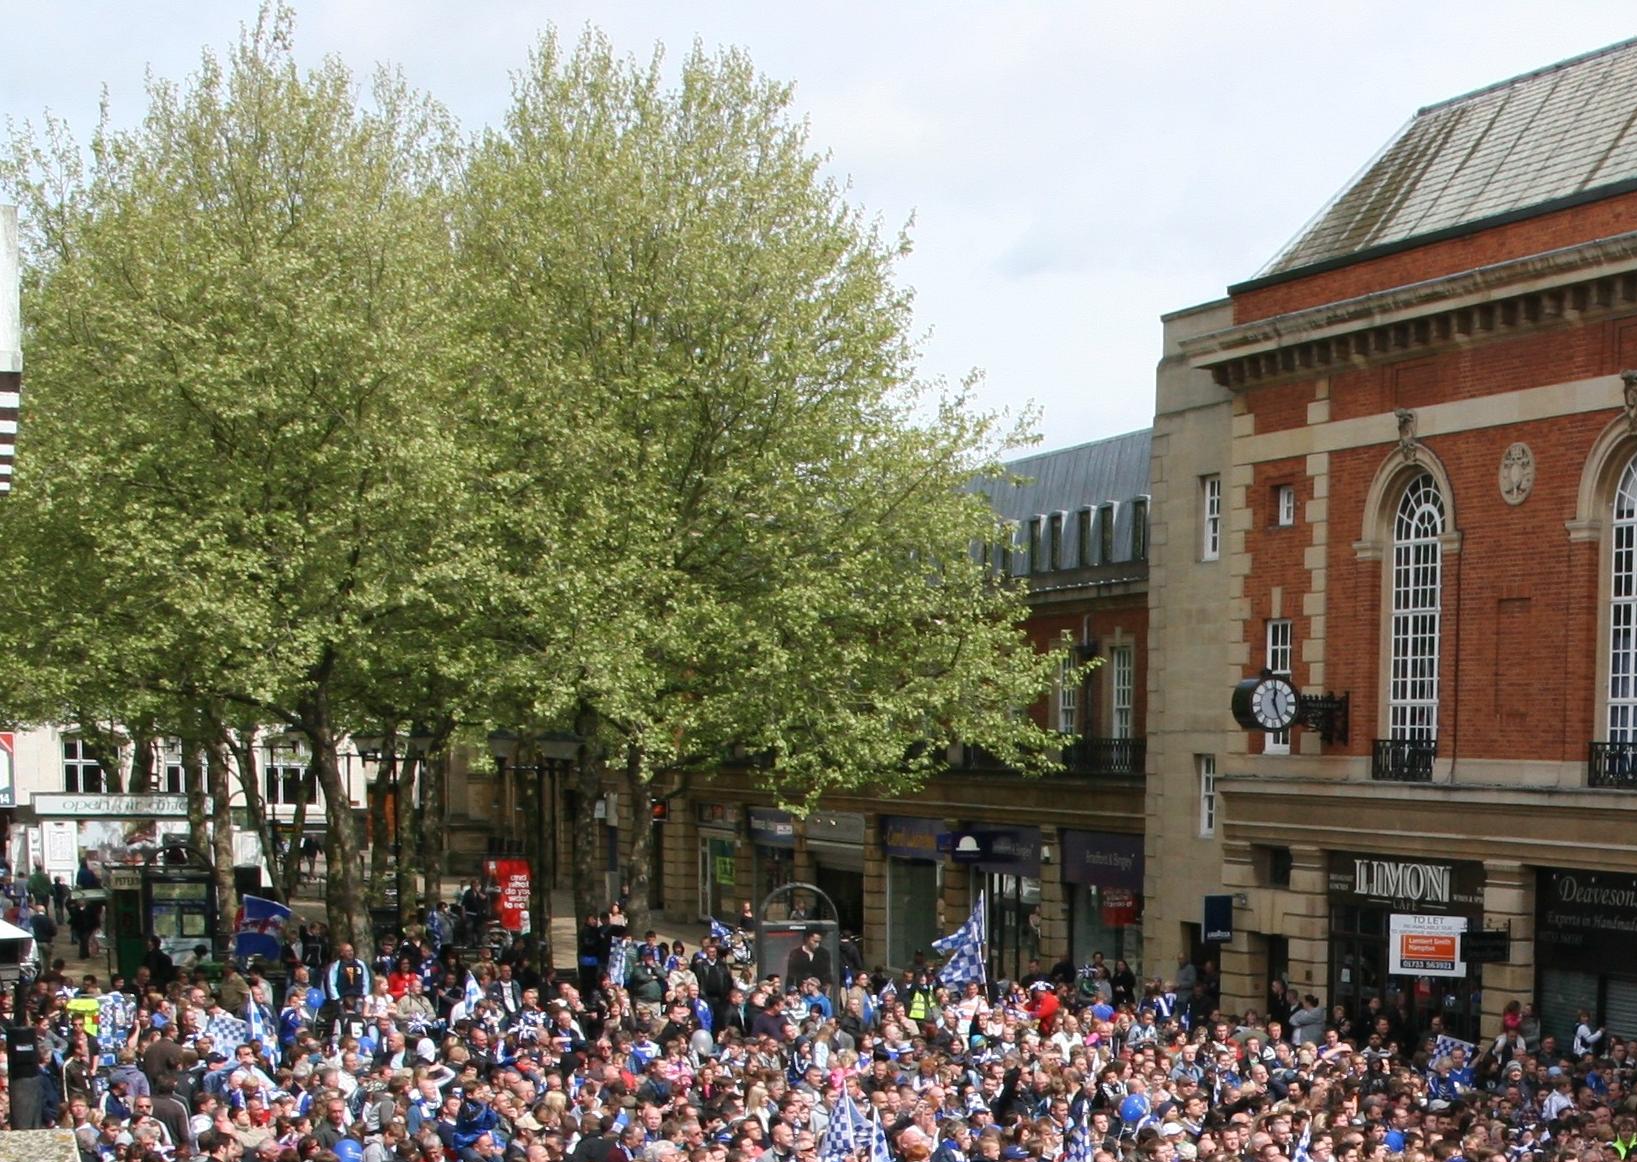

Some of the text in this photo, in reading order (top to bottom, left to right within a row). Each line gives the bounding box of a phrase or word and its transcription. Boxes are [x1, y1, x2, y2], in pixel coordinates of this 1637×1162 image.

[1354, 859, 1452, 902] LIMON
[1413, 916, 1444, 925] TO LET
